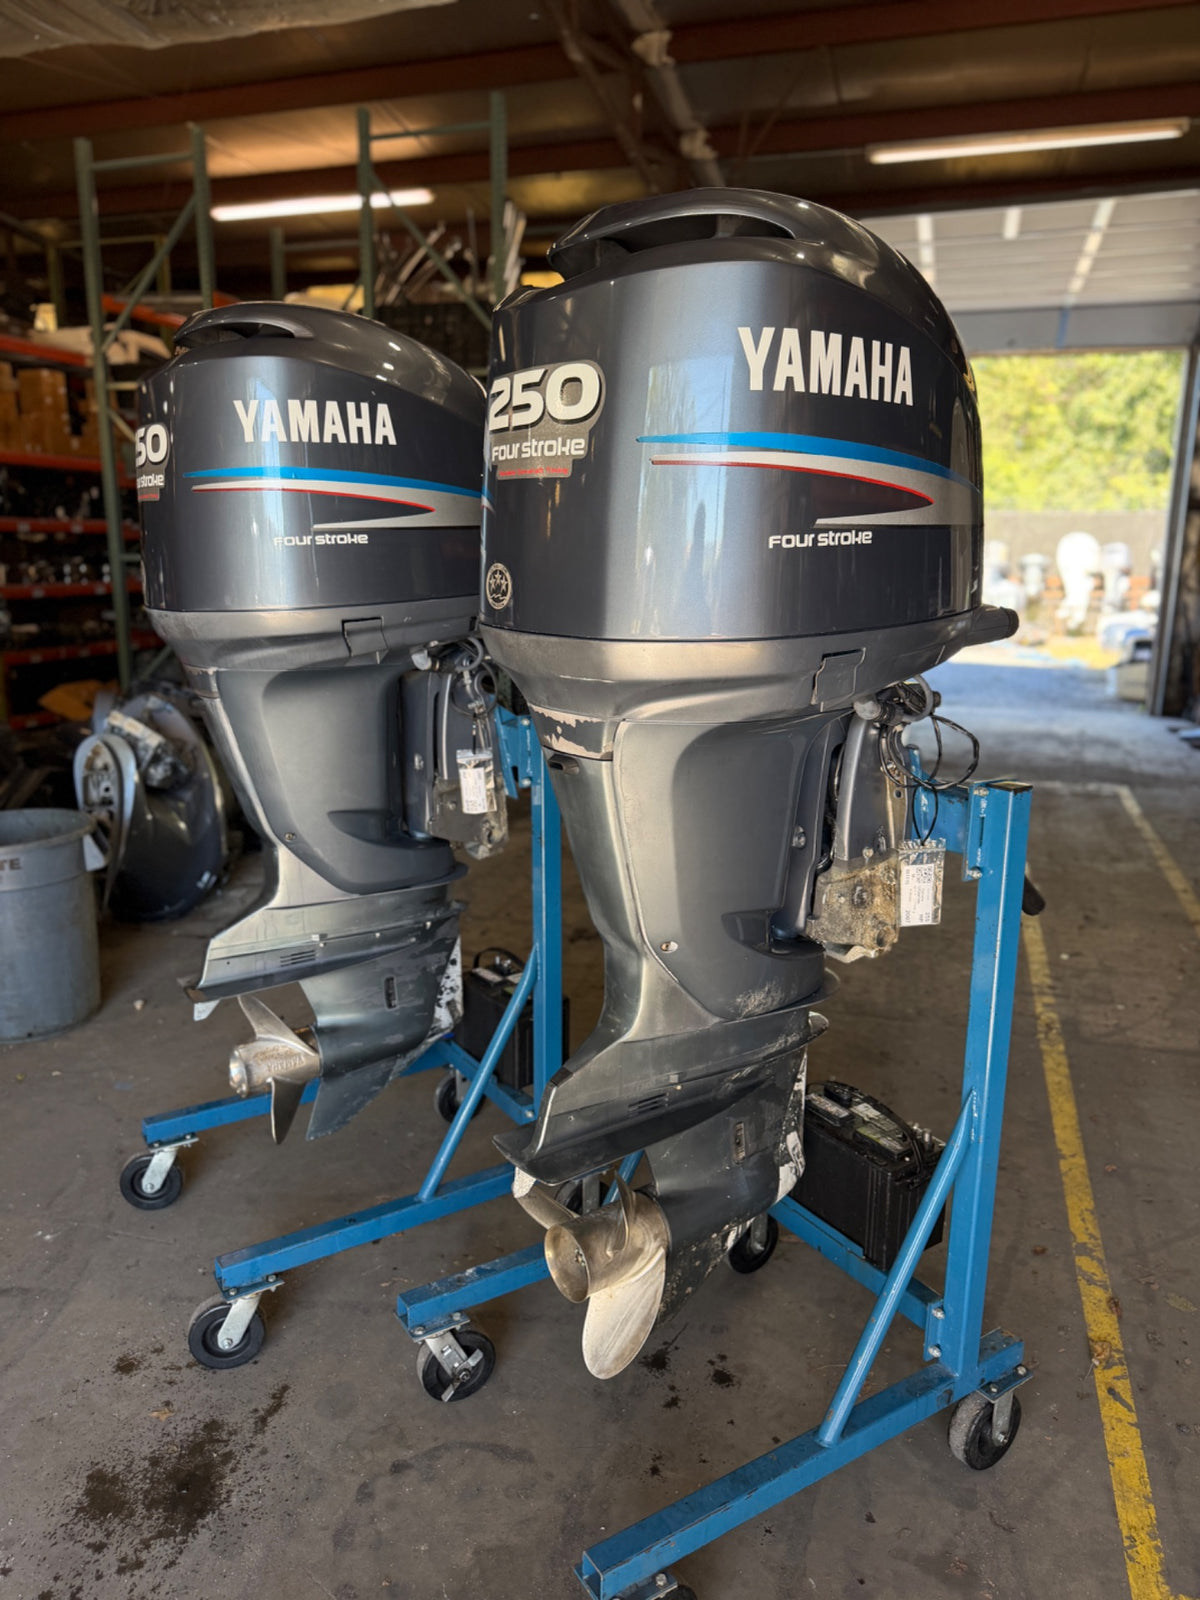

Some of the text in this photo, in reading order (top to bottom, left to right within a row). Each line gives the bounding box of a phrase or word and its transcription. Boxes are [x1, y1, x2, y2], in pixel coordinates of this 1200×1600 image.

[737, 327, 914, 406] YAMAHA
[489, 363, 601, 433] 250
[233, 399, 398, 445] YAMAHA
[521, 437, 586, 458] stroke
[314, 533, 369, 545] stroke
[817, 529, 873, 547] stroke
